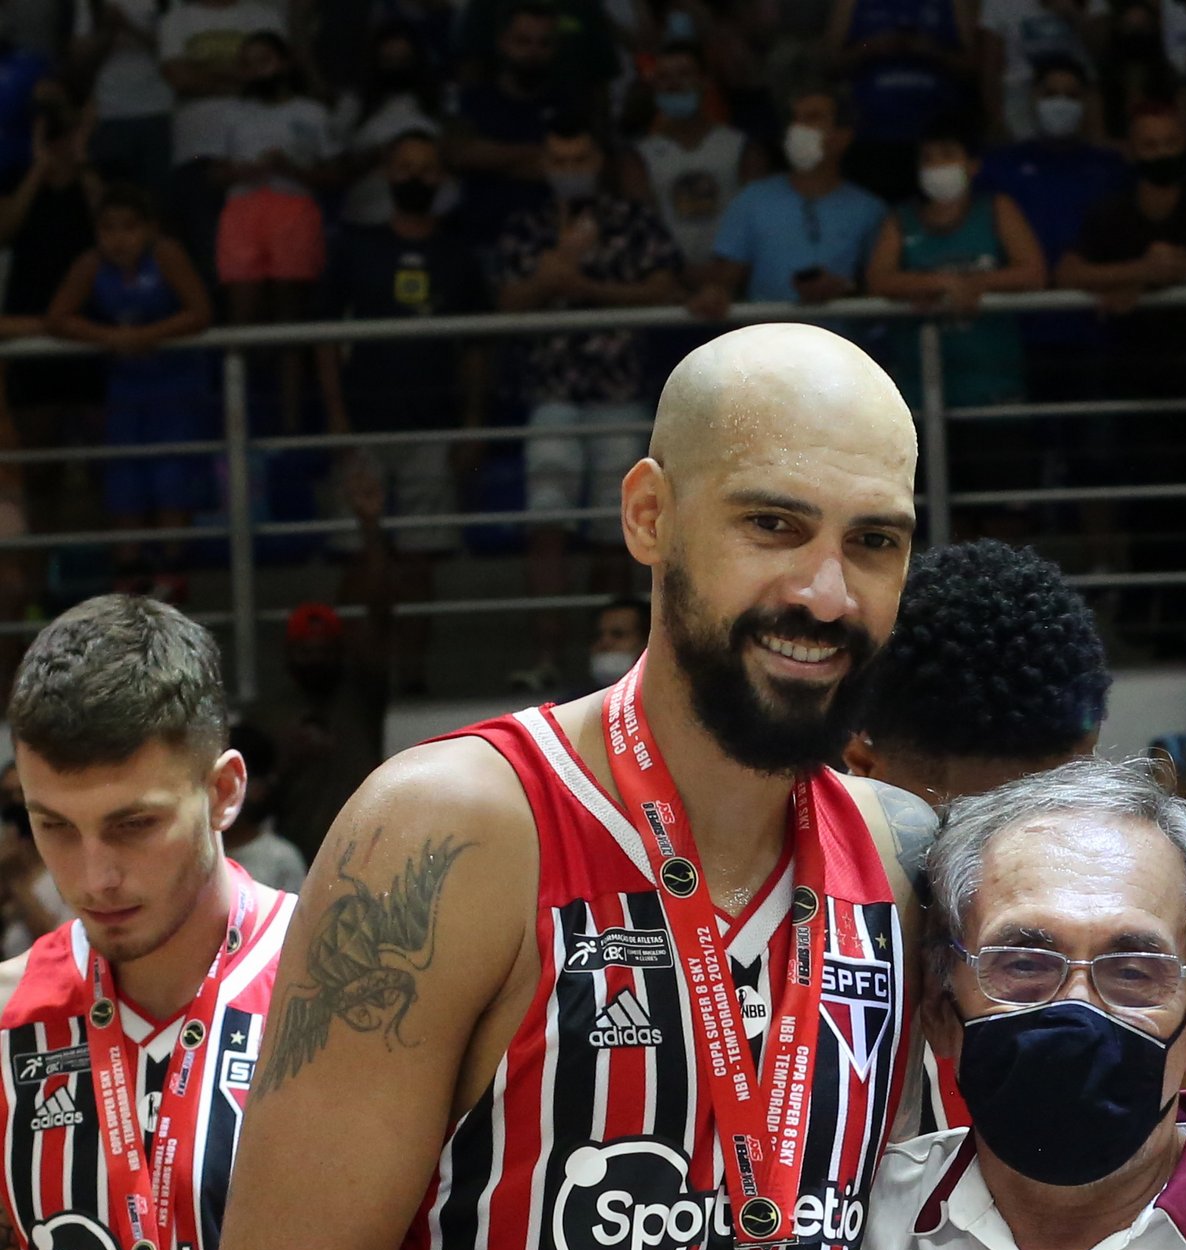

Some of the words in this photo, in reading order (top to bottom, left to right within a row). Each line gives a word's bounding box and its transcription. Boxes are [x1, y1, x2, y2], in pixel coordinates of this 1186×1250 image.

[609, 720, 626, 754] COPA
[634, 741, 653, 770] NBB
[697, 926, 722, 981] 2021/22
[688, 957, 704, 982] SKY
[822, 965, 888, 999] SPFC
[695, 985, 707, 994] 8
[699, 997, 718, 1038] SUPER
[712, 982, 741, 1063] TEMPORADA
[742, 1004, 766, 1018] NBB
[589, 1025, 663, 1047] adidas
[779, 1015, 796, 1044] NBB
[710, 1041, 727, 1076] COPA
[792, 1045, 809, 1082] COPA
[732, 1072, 750, 1101] NBB
[765, 1053, 790, 1133] TEMPORADA
[785, 1083, 804, 1126] SUPER
[31, 1112, 84, 1130] adidas
[783, 1127, 797, 1138] 8
[779, 1139, 795, 1167] SKY
